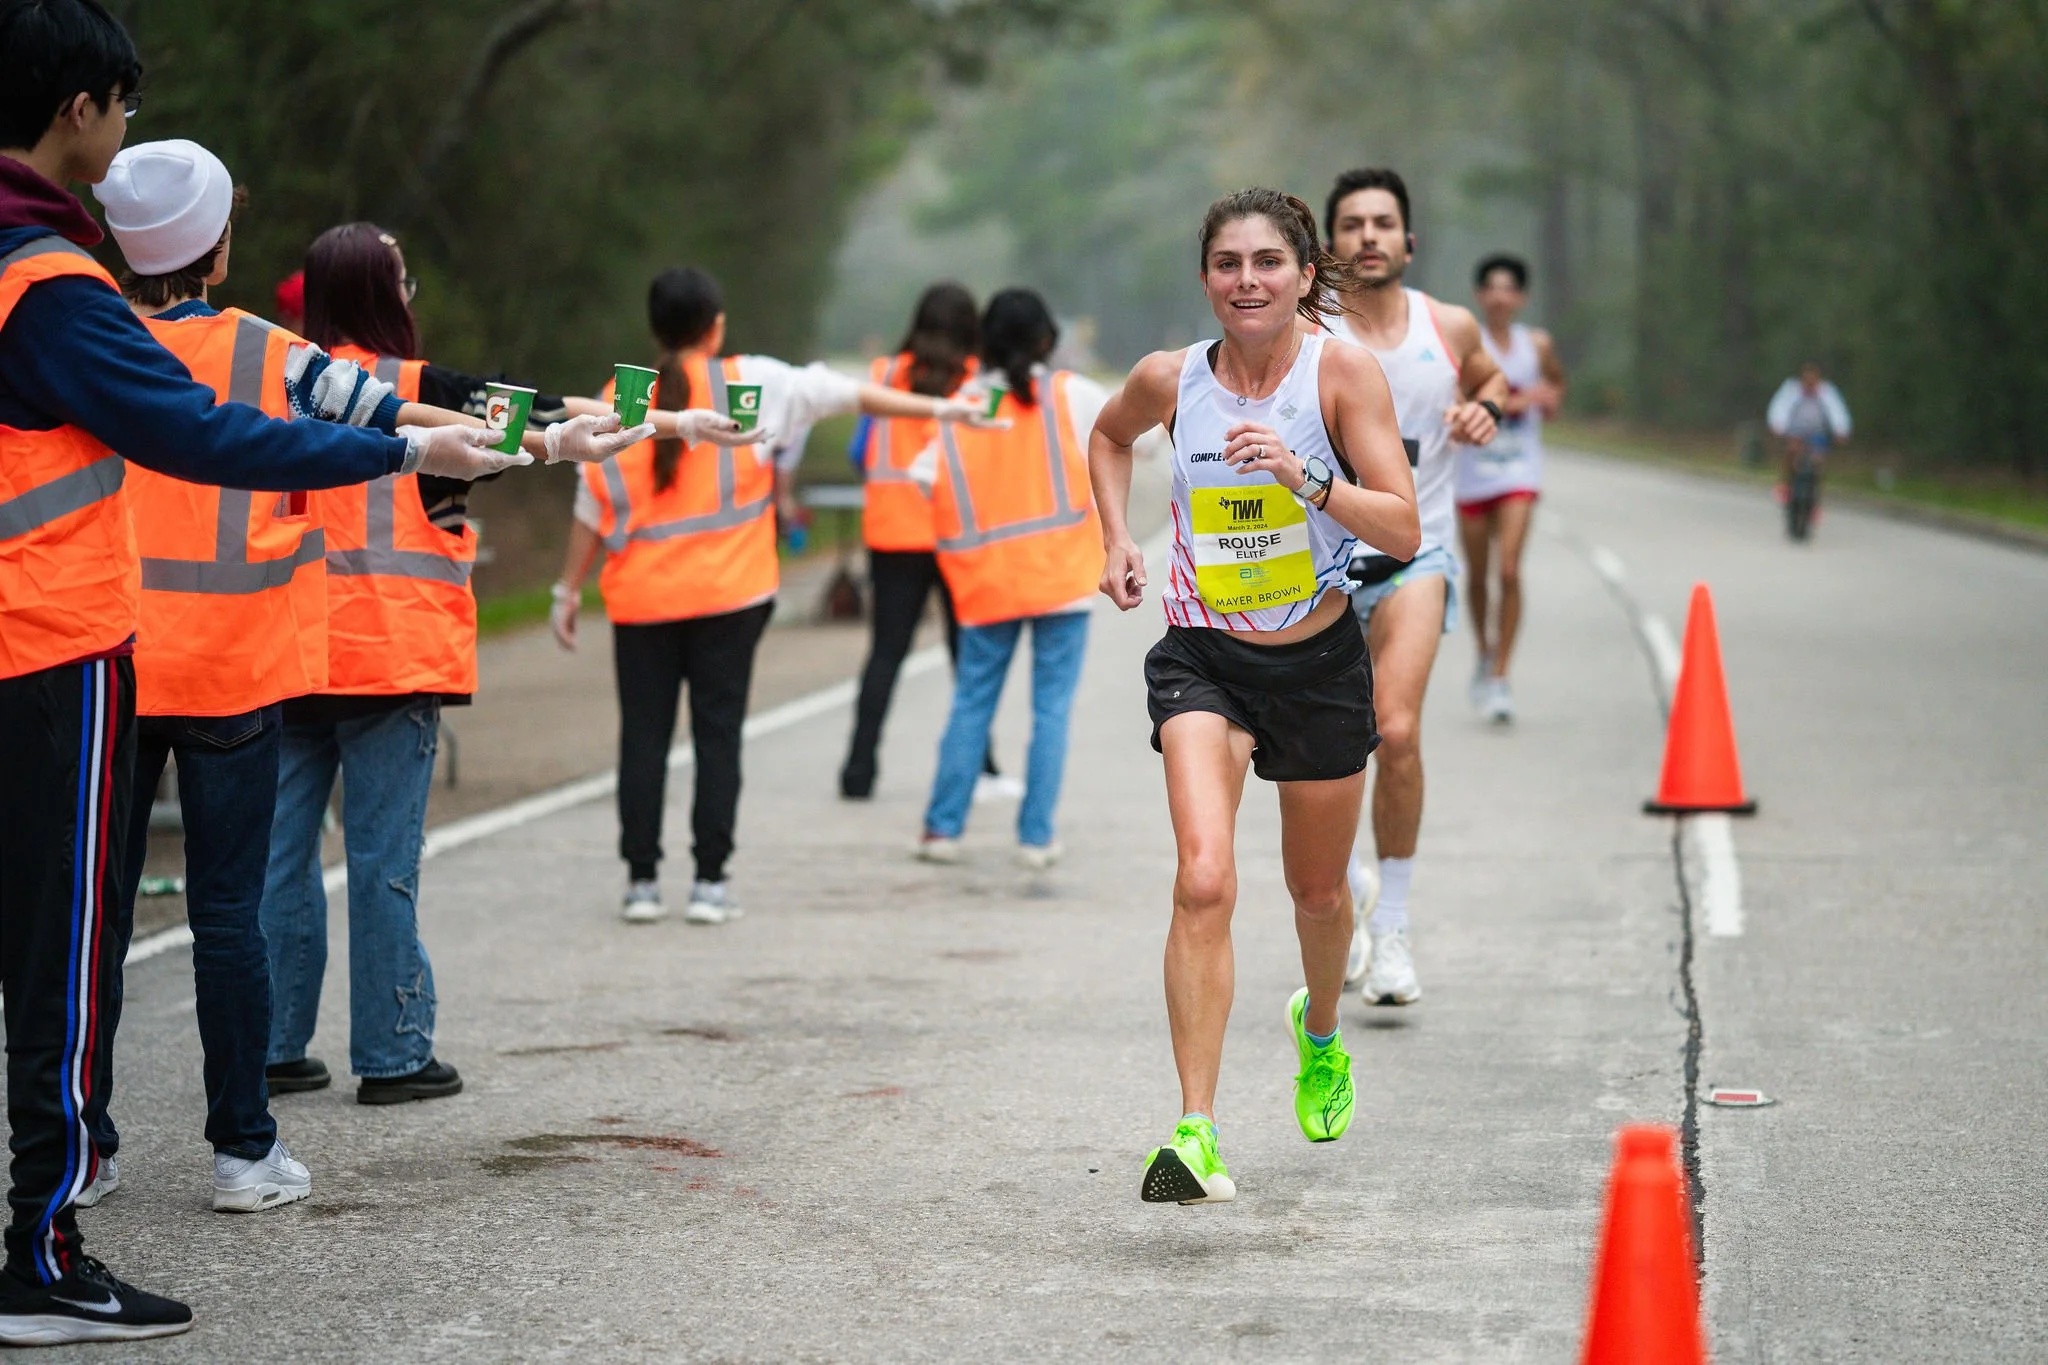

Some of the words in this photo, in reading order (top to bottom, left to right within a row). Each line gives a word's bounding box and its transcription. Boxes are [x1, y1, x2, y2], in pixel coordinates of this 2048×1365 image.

[739, 391, 757, 409] G
[486, 396, 510, 430] G
[1190, 452, 1226, 463] COMPLE
[1218, 533, 1282, 549] ROUSE
[1236, 549, 1267, 559] ELITE
[1215, 596, 1253, 607] MAYER
[1258, 585, 1301, 603] BROWN
